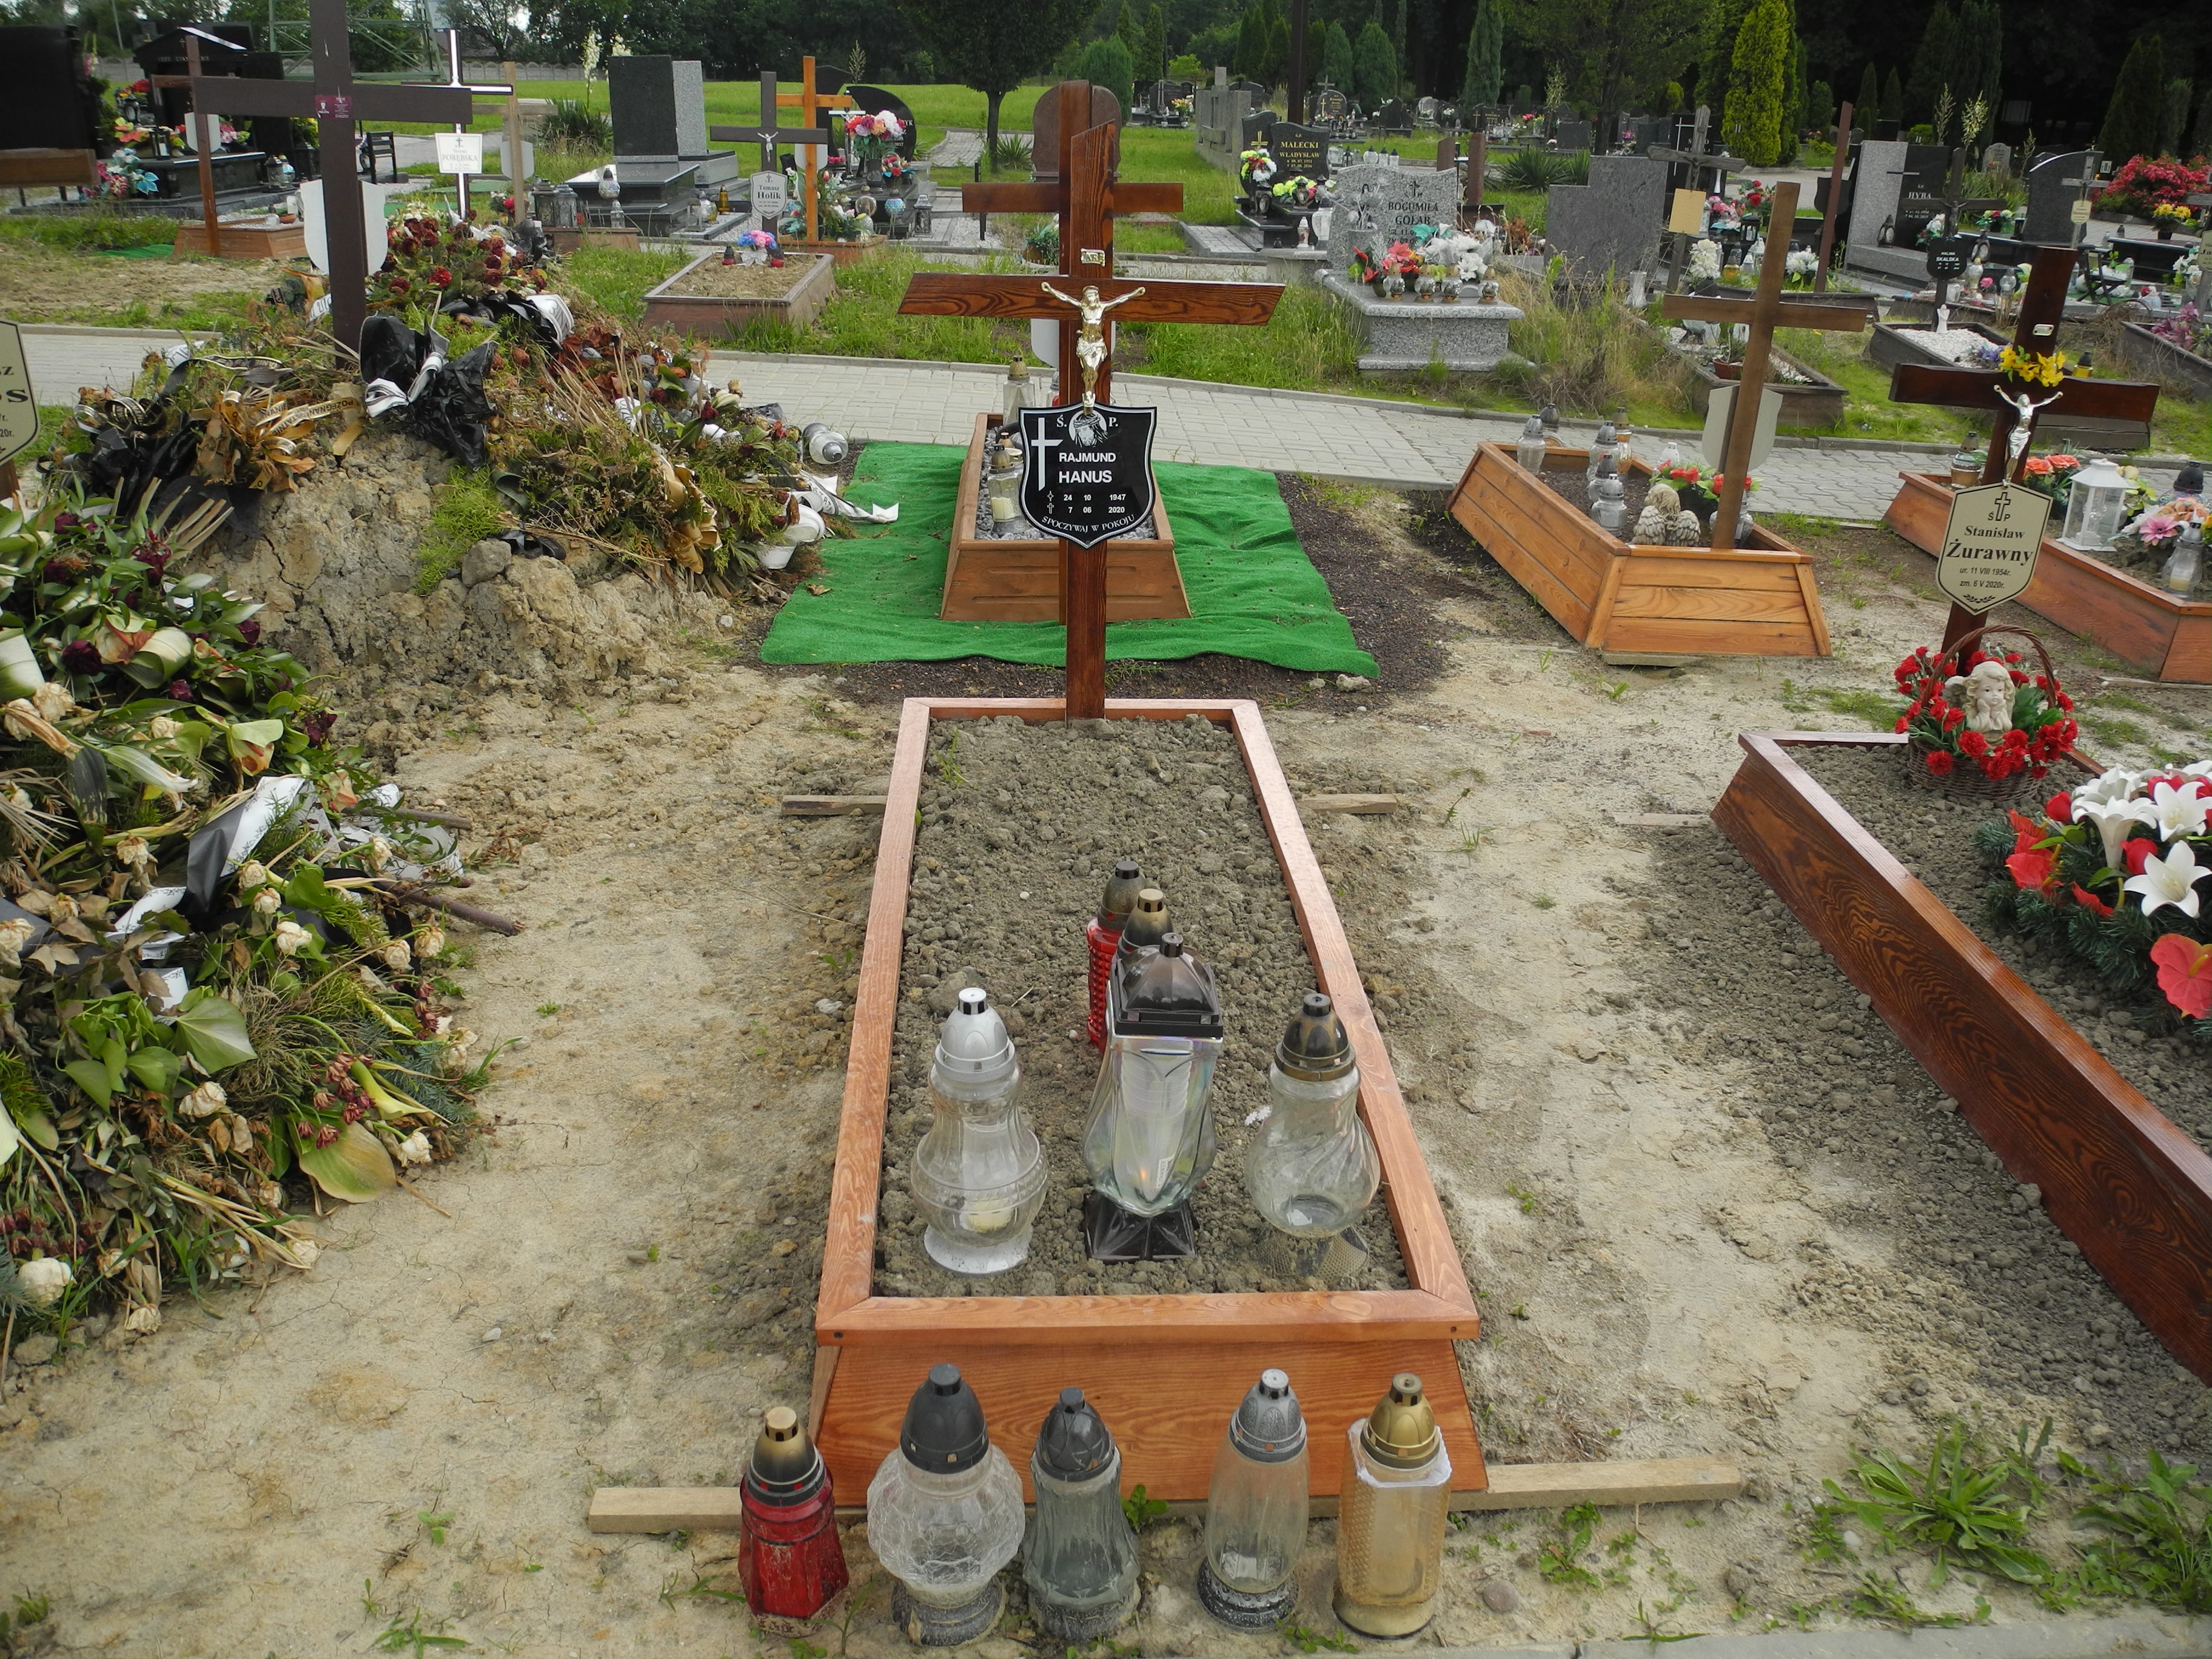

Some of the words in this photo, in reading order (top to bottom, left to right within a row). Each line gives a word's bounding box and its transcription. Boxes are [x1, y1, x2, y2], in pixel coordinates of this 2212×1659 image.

[1059, 452, 1116, 463] RAJMUND
[1059, 470, 1113, 484] HANUS
[1988, 511, 1994, 521] Ś
[1041, 515, 1088, 533] SPOCZYWAJ
[1102, 514, 1135, 531] POKOJU
[1946, 538, 2034, 566] Żurawny
